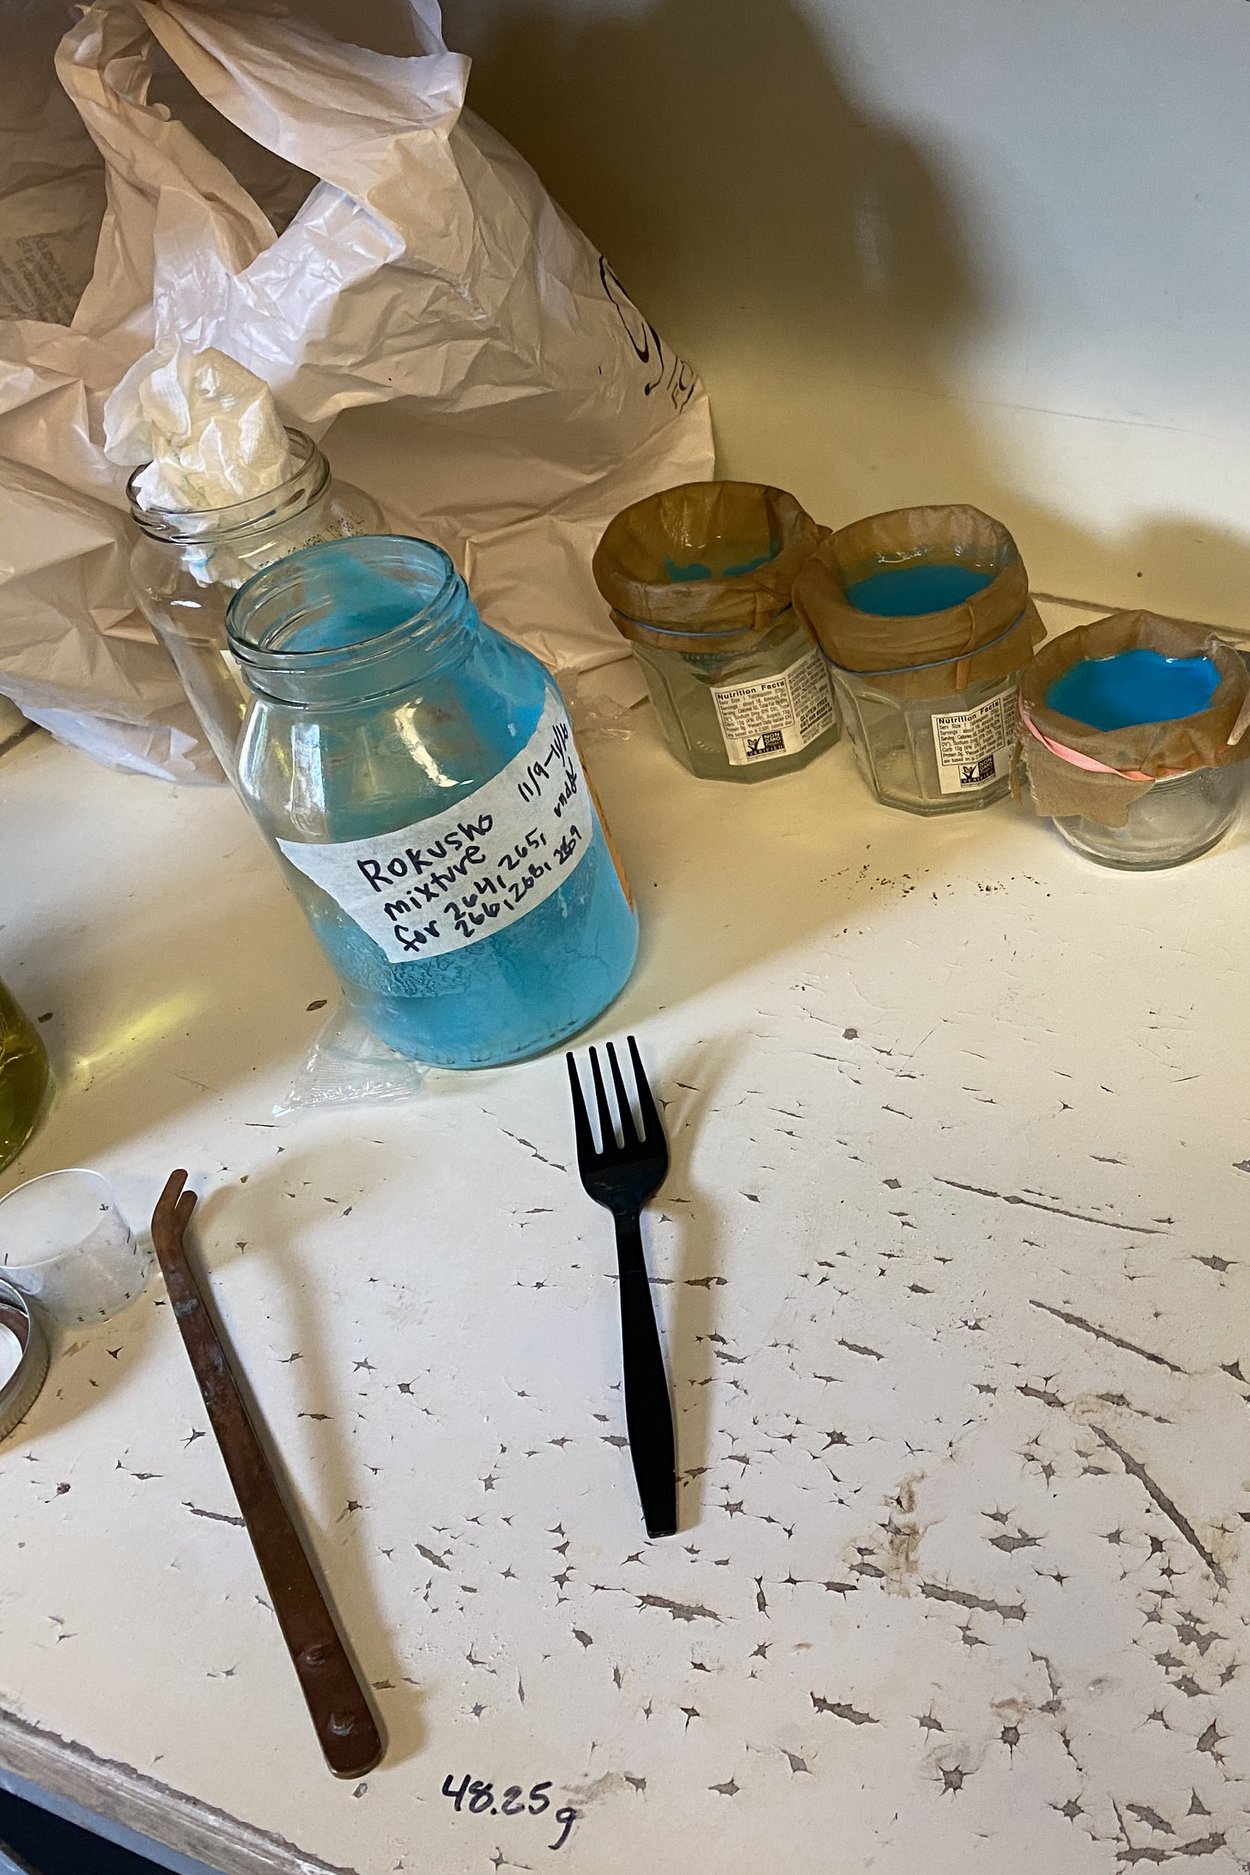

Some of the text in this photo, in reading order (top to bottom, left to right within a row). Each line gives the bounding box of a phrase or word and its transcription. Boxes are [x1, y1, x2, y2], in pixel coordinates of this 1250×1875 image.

[716, 680, 786, 701] Nutrition Facts
[938, 701, 999, 724] Nutrition Facts
[384, 845, 486, 921] mixture
[394, 920, 440, 952] for
[441, 1774, 578, 1850] 48.25 g
